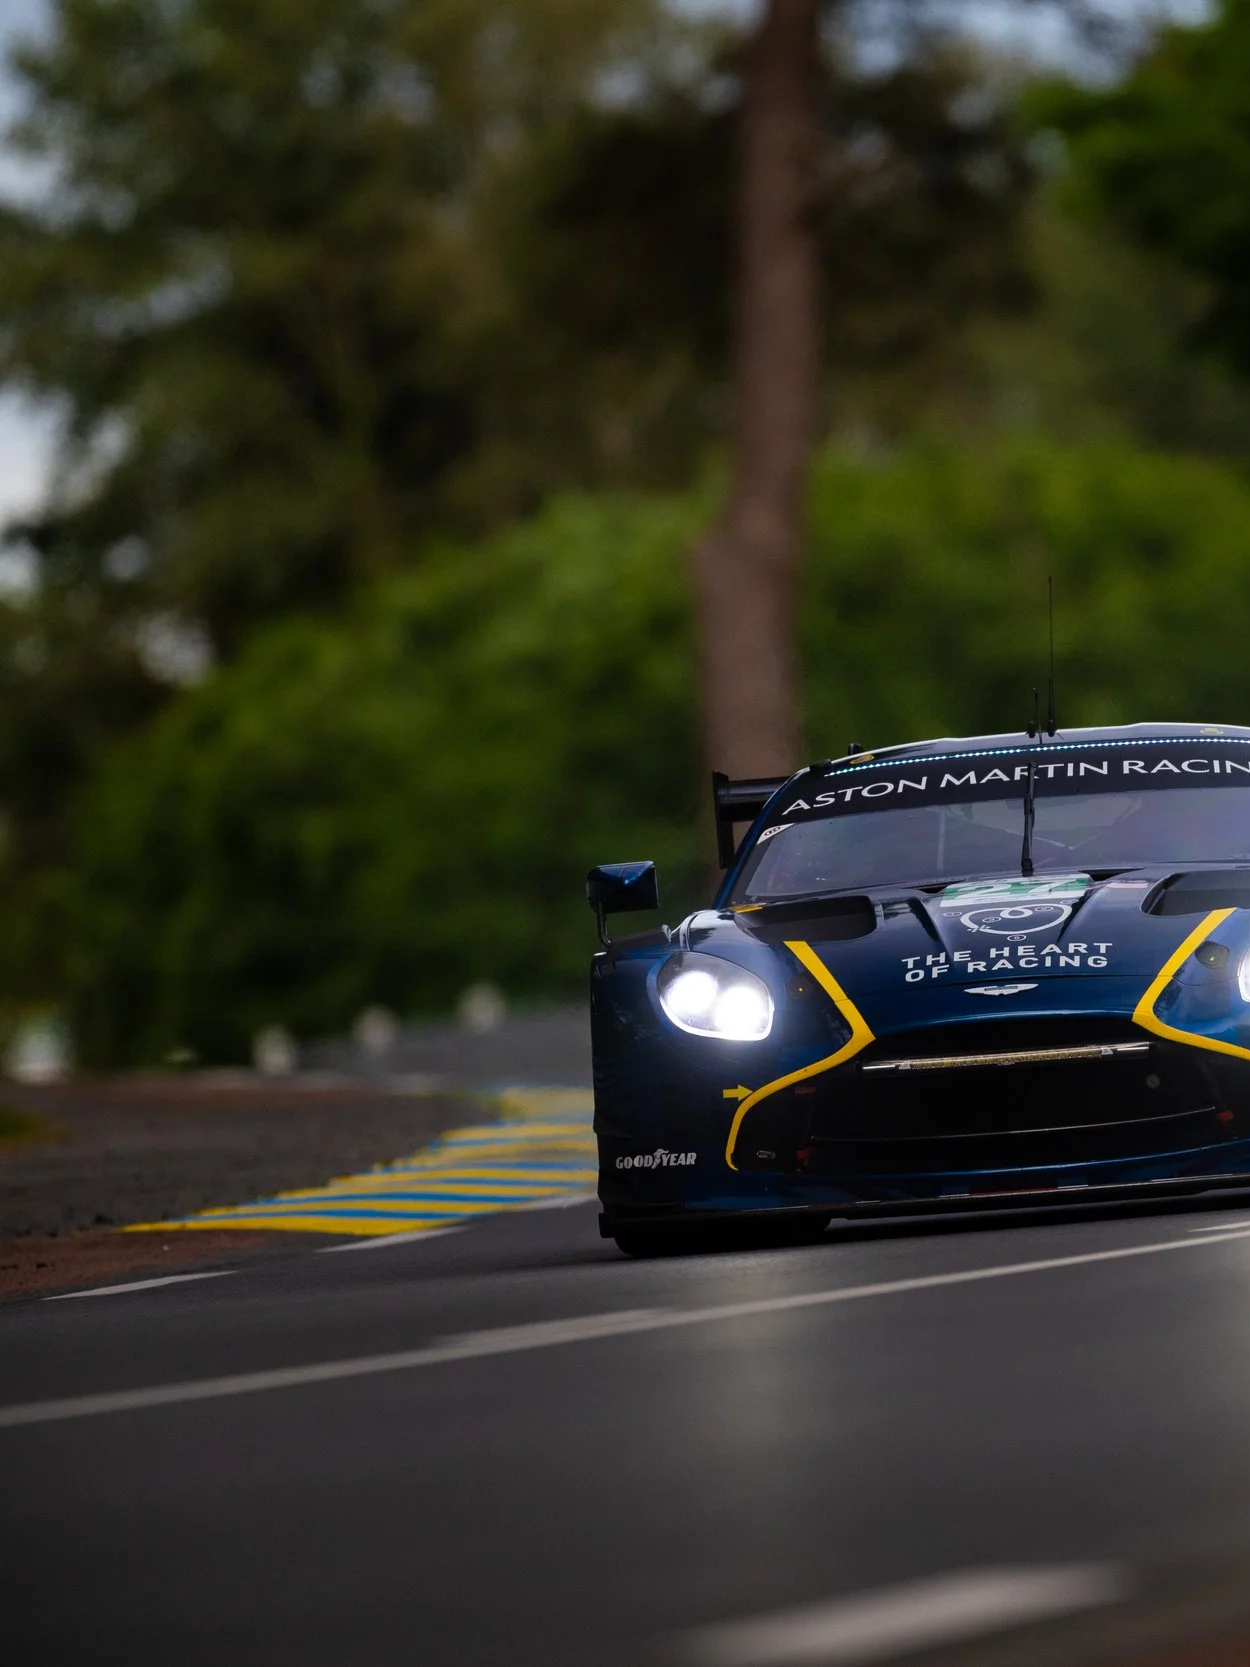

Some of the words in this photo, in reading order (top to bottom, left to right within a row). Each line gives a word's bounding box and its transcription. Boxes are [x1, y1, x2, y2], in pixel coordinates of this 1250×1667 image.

[781, 776, 927, 816] ASTON
[940, 760, 1108, 788] MARTIN
[955, 879, 1077, 900] 27
[901, 950, 971, 969] THE
[990, 942, 1113, 958] HEART
[904, 964, 950, 983] OF
[967, 955, 1108, 973] RACING
[615, 1148, 697, 1170] GOODYEAR
